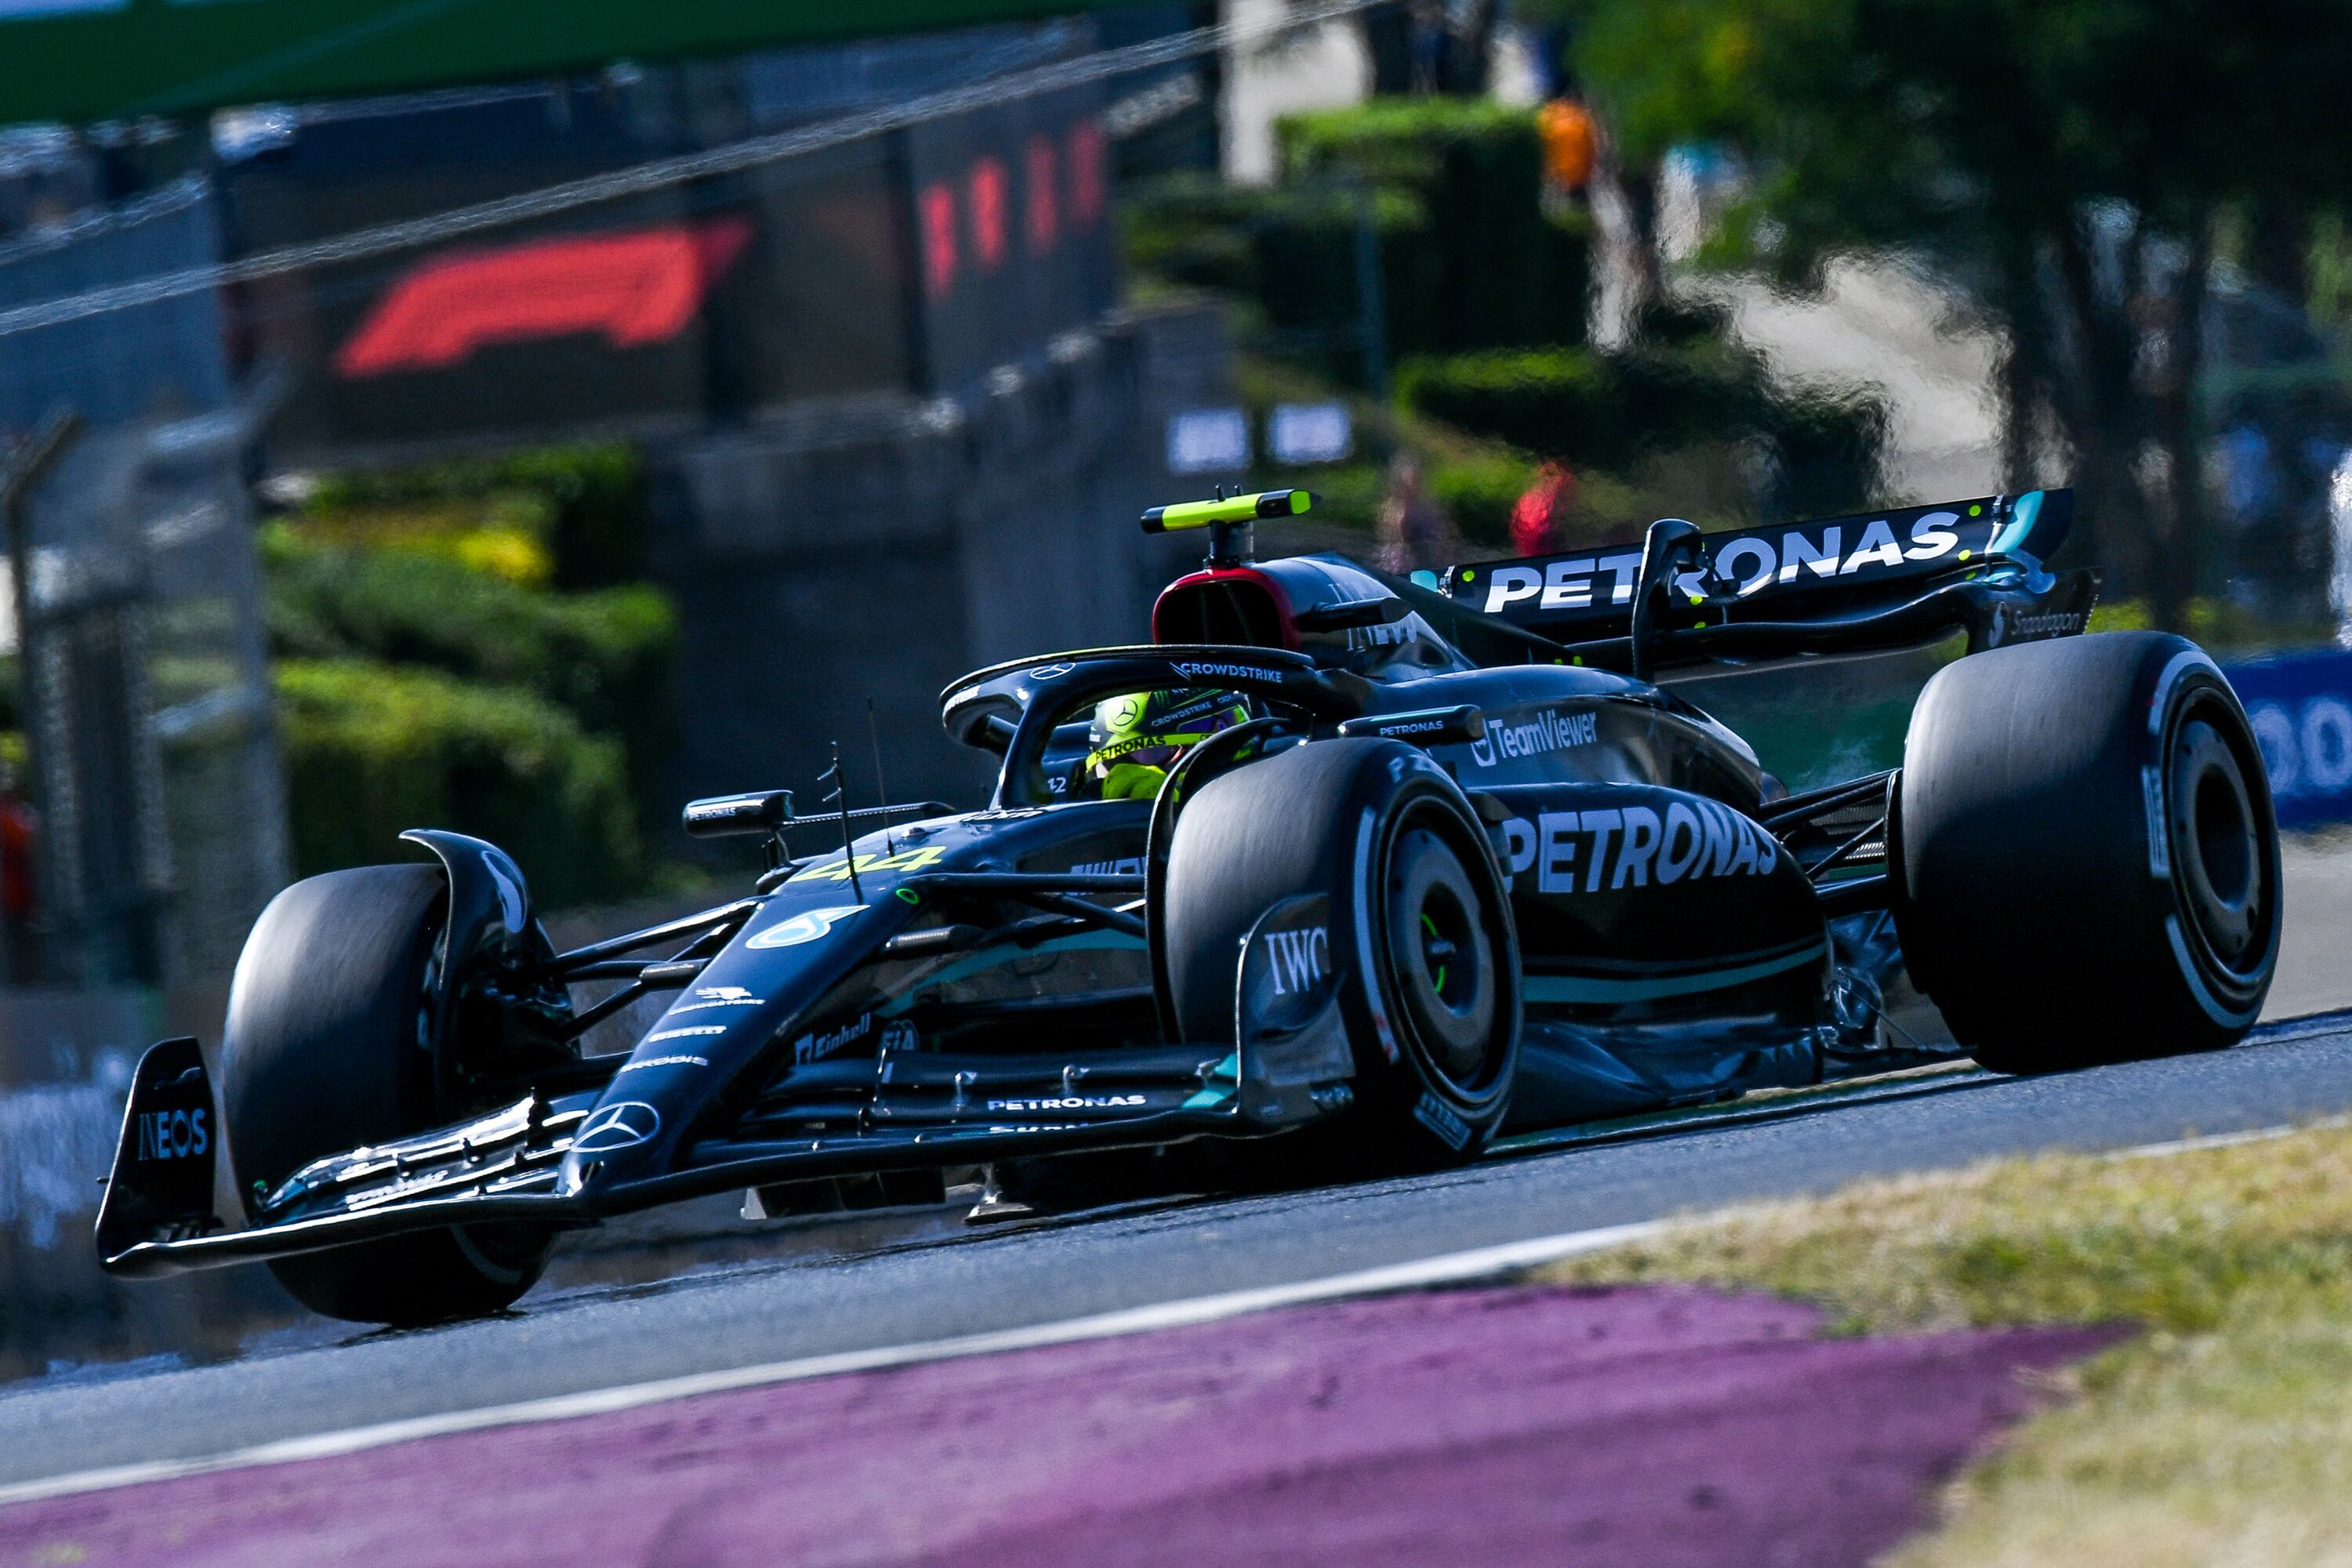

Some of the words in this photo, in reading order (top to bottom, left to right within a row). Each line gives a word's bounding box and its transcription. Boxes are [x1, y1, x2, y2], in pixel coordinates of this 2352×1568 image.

[1180, 662, 1283, 684] CROWDSTRIKE
[1151, 701, 1212, 727] CROWDSTRIKE
[1379, 720, 1444, 737] PETRONAS
[1489, 709, 1598, 759] TeamViewer
[1095, 735, 1167, 761] PETRONAS
[790, 846, 947, 882] 44
[1264, 926, 1328, 996] IWC
[987, 1094, 1146, 1111] PETRONAS
[138, 1108, 209, 1161] INEOS
